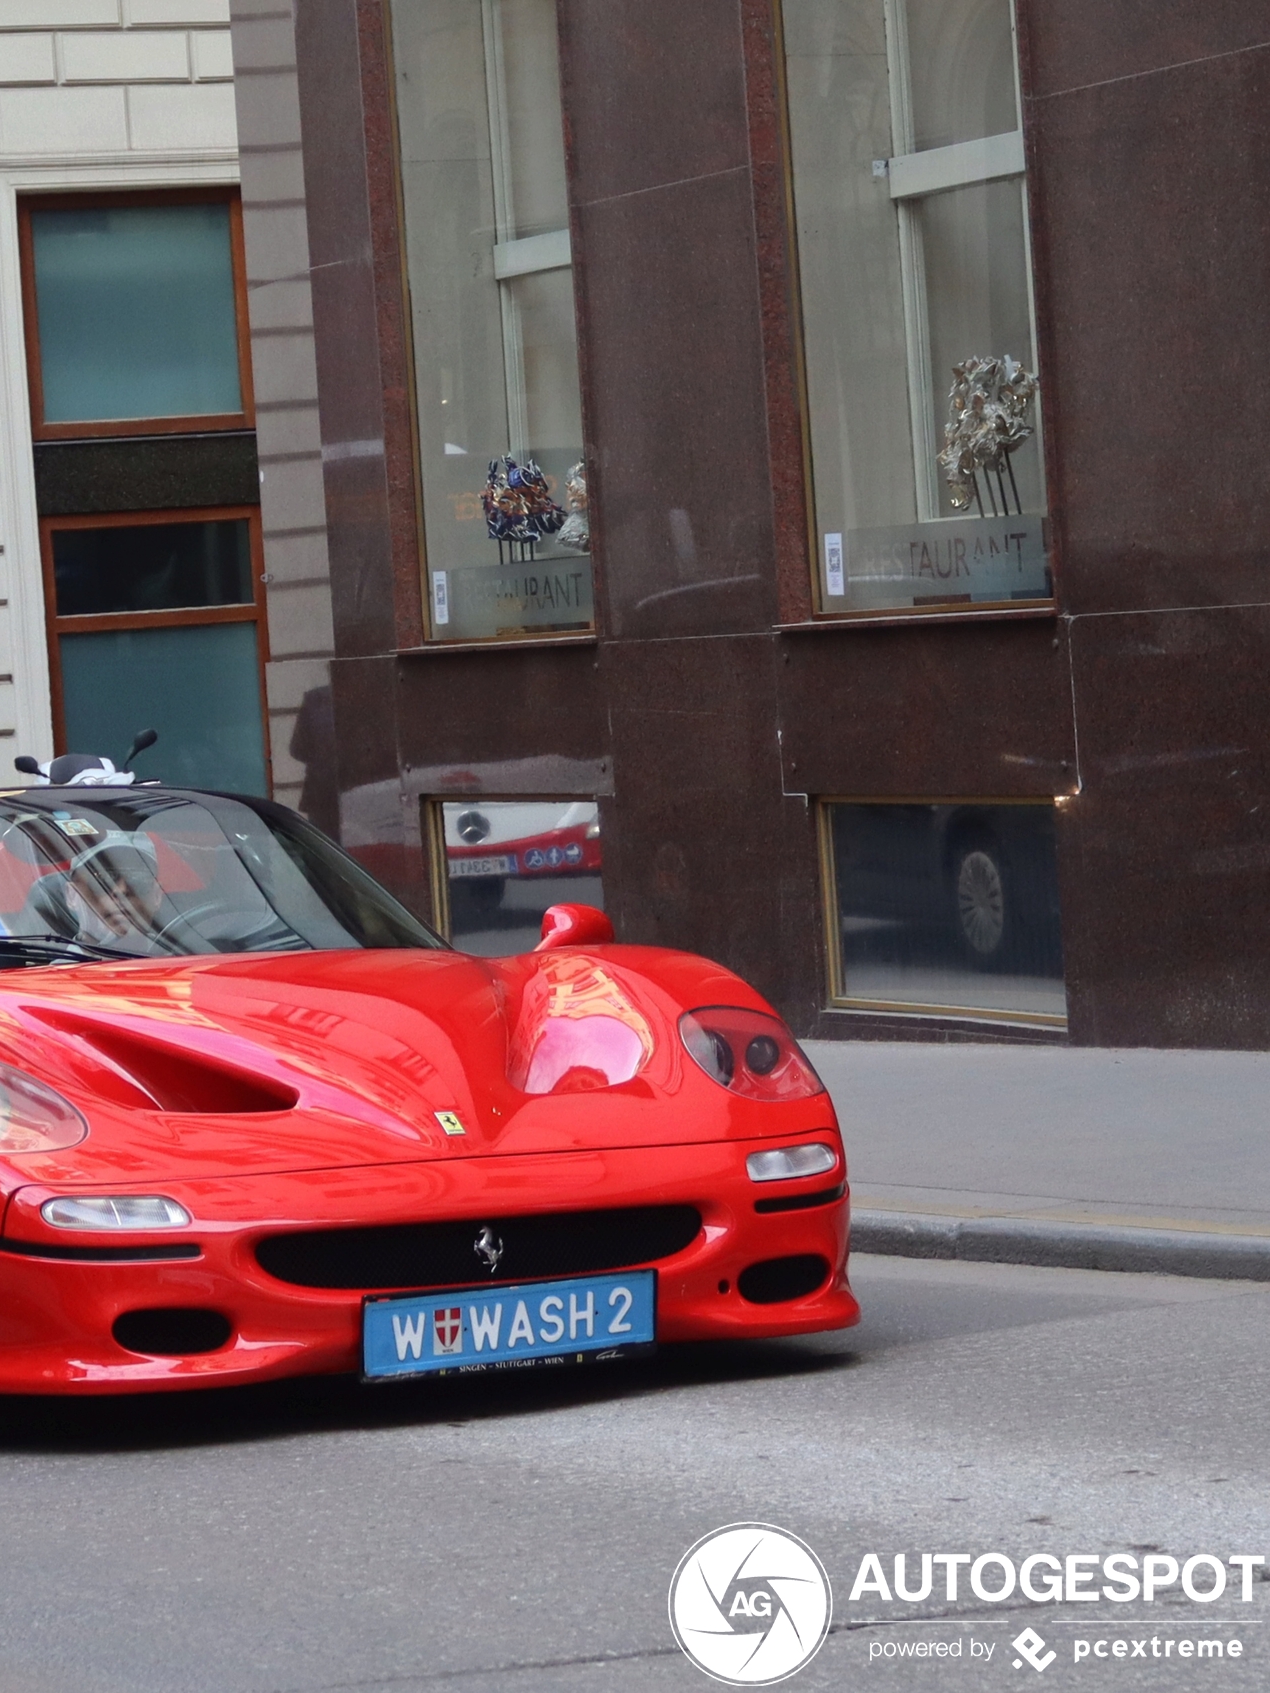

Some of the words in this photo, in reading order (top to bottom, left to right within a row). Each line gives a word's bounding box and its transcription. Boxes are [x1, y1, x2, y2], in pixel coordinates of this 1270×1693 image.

[392, 1311, 426, 1361] W
[469, 1291, 594, 1352] WASH
[608, 1286, 633, 1334] 2
[459, 1363, 487, 1373] SINGEN
[495, 1358, 536, 1369] STUTTGART
[544, 1356, 564, 1365] WIEN
